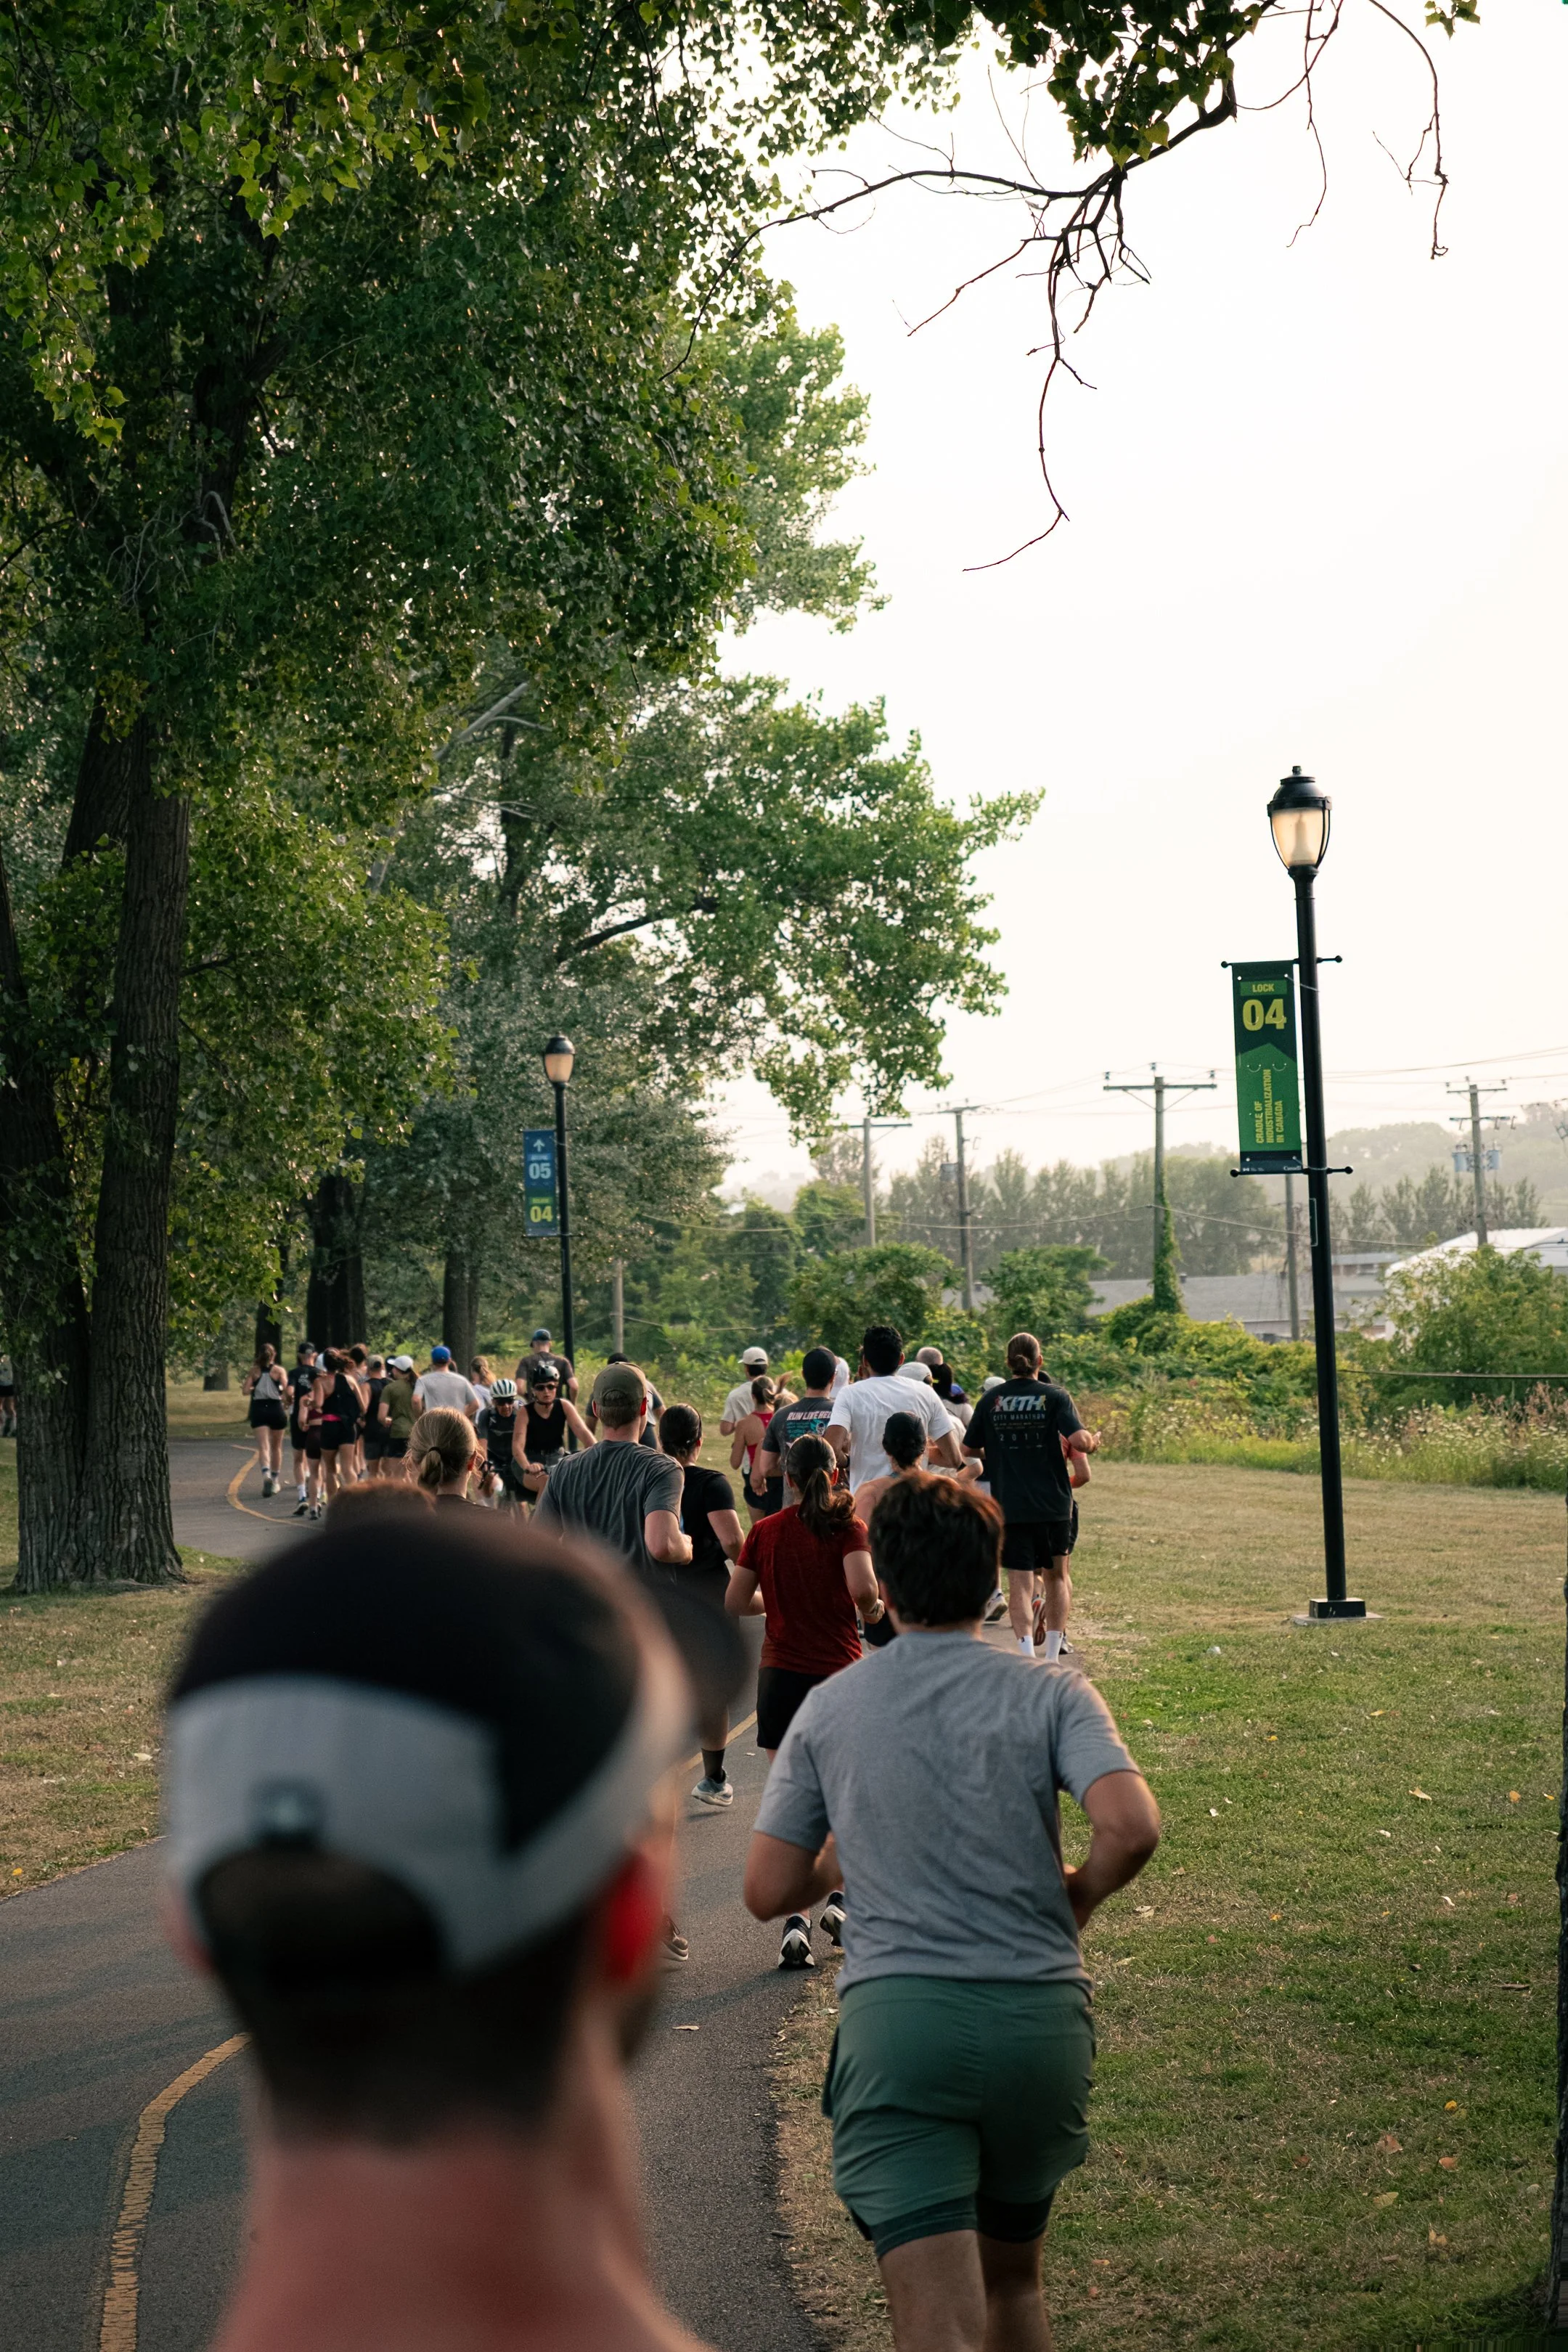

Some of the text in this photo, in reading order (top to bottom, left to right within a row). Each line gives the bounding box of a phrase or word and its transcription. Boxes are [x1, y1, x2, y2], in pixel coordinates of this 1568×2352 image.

[1252, 984, 1275, 993] LOCK
[1242, 998, 1287, 1031] 04
[1263, 1069, 1275, 1143] INDUSTRIALIZATION
[1254, 1101, 1265, 1144] CRADLE OF
[1275, 1100, 1285, 1143] IN CANADA
[528, 1163, 552, 1180] 05
[530, 1205, 553, 1223] 04
[995, 1395, 1045, 1412] KITH
[786, 1412, 804, 1421] RUN
[802, 1411, 820, 1420] LIKE
